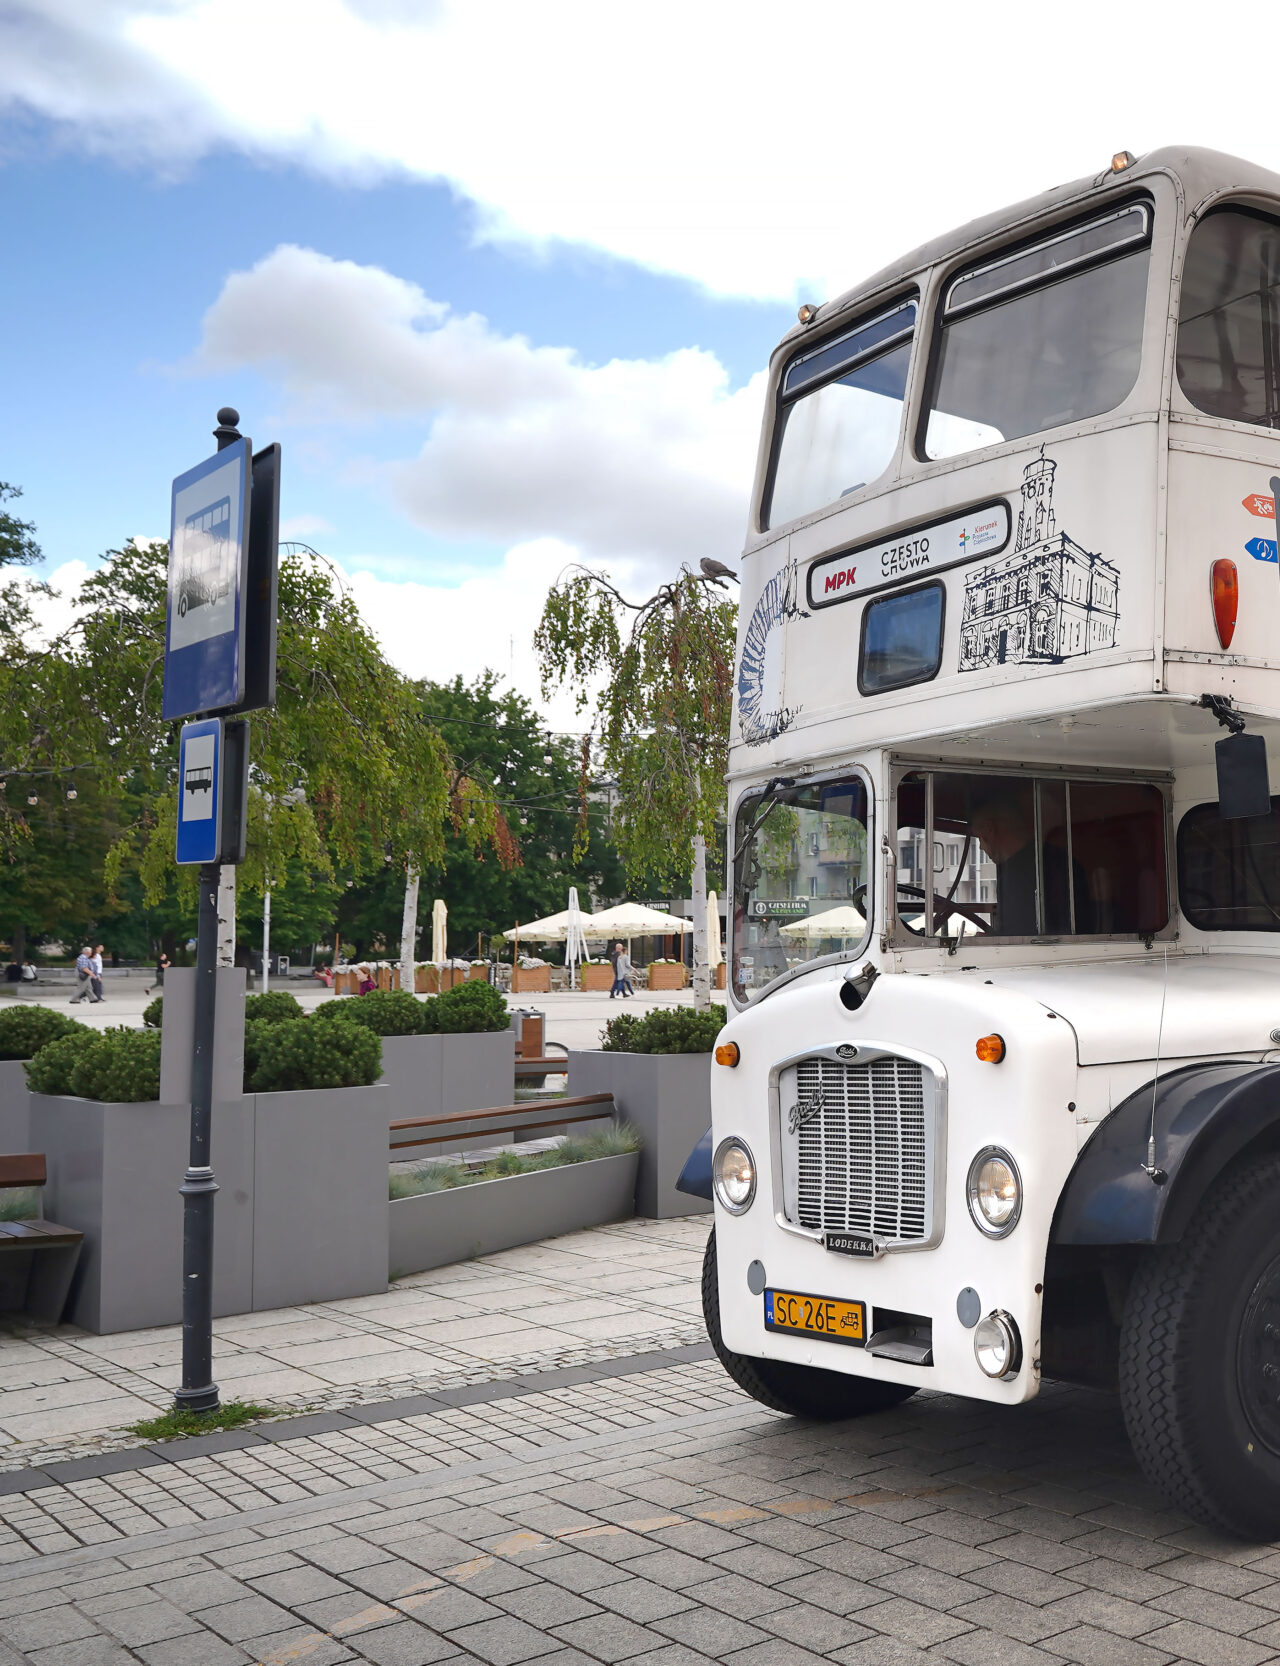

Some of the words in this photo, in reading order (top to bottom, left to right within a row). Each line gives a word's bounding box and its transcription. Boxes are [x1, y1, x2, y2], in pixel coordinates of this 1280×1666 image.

[824, 566, 857, 593] MPK
[829, 1237, 873, 1252] LODEKKA
[767, 1310, 774, 1320] PL
[776, 1295, 799, 1326] SC
[804, 1300, 836, 1333] 26E
